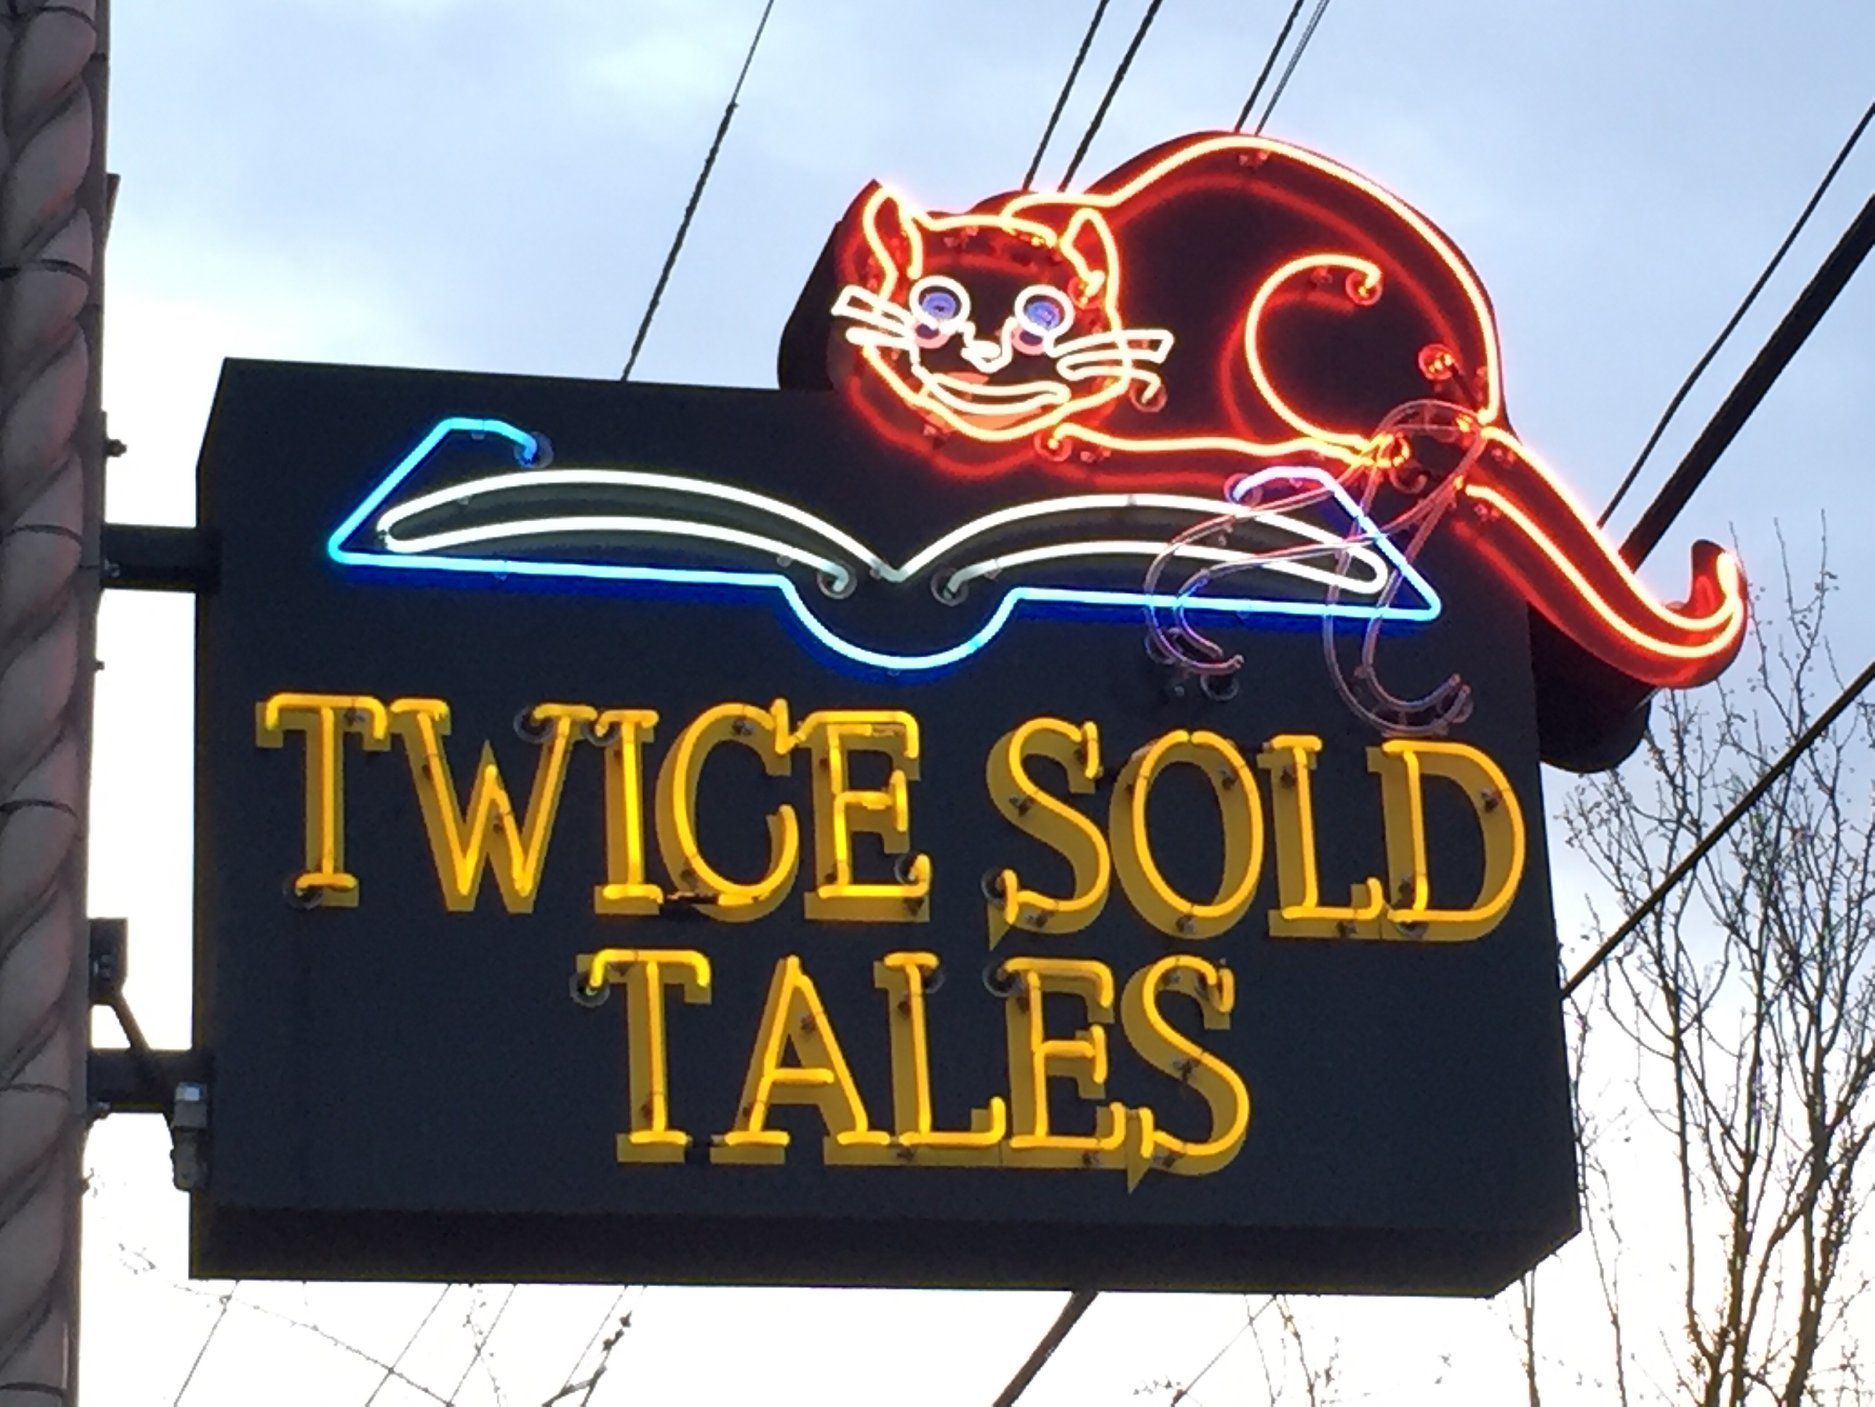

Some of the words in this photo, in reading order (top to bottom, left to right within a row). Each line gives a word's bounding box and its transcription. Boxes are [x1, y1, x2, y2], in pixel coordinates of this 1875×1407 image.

[255, 691, 933, 924] TWICE
[986, 716, 1527, 947] SOLD
[575, 947, 1252, 1191] TALES
